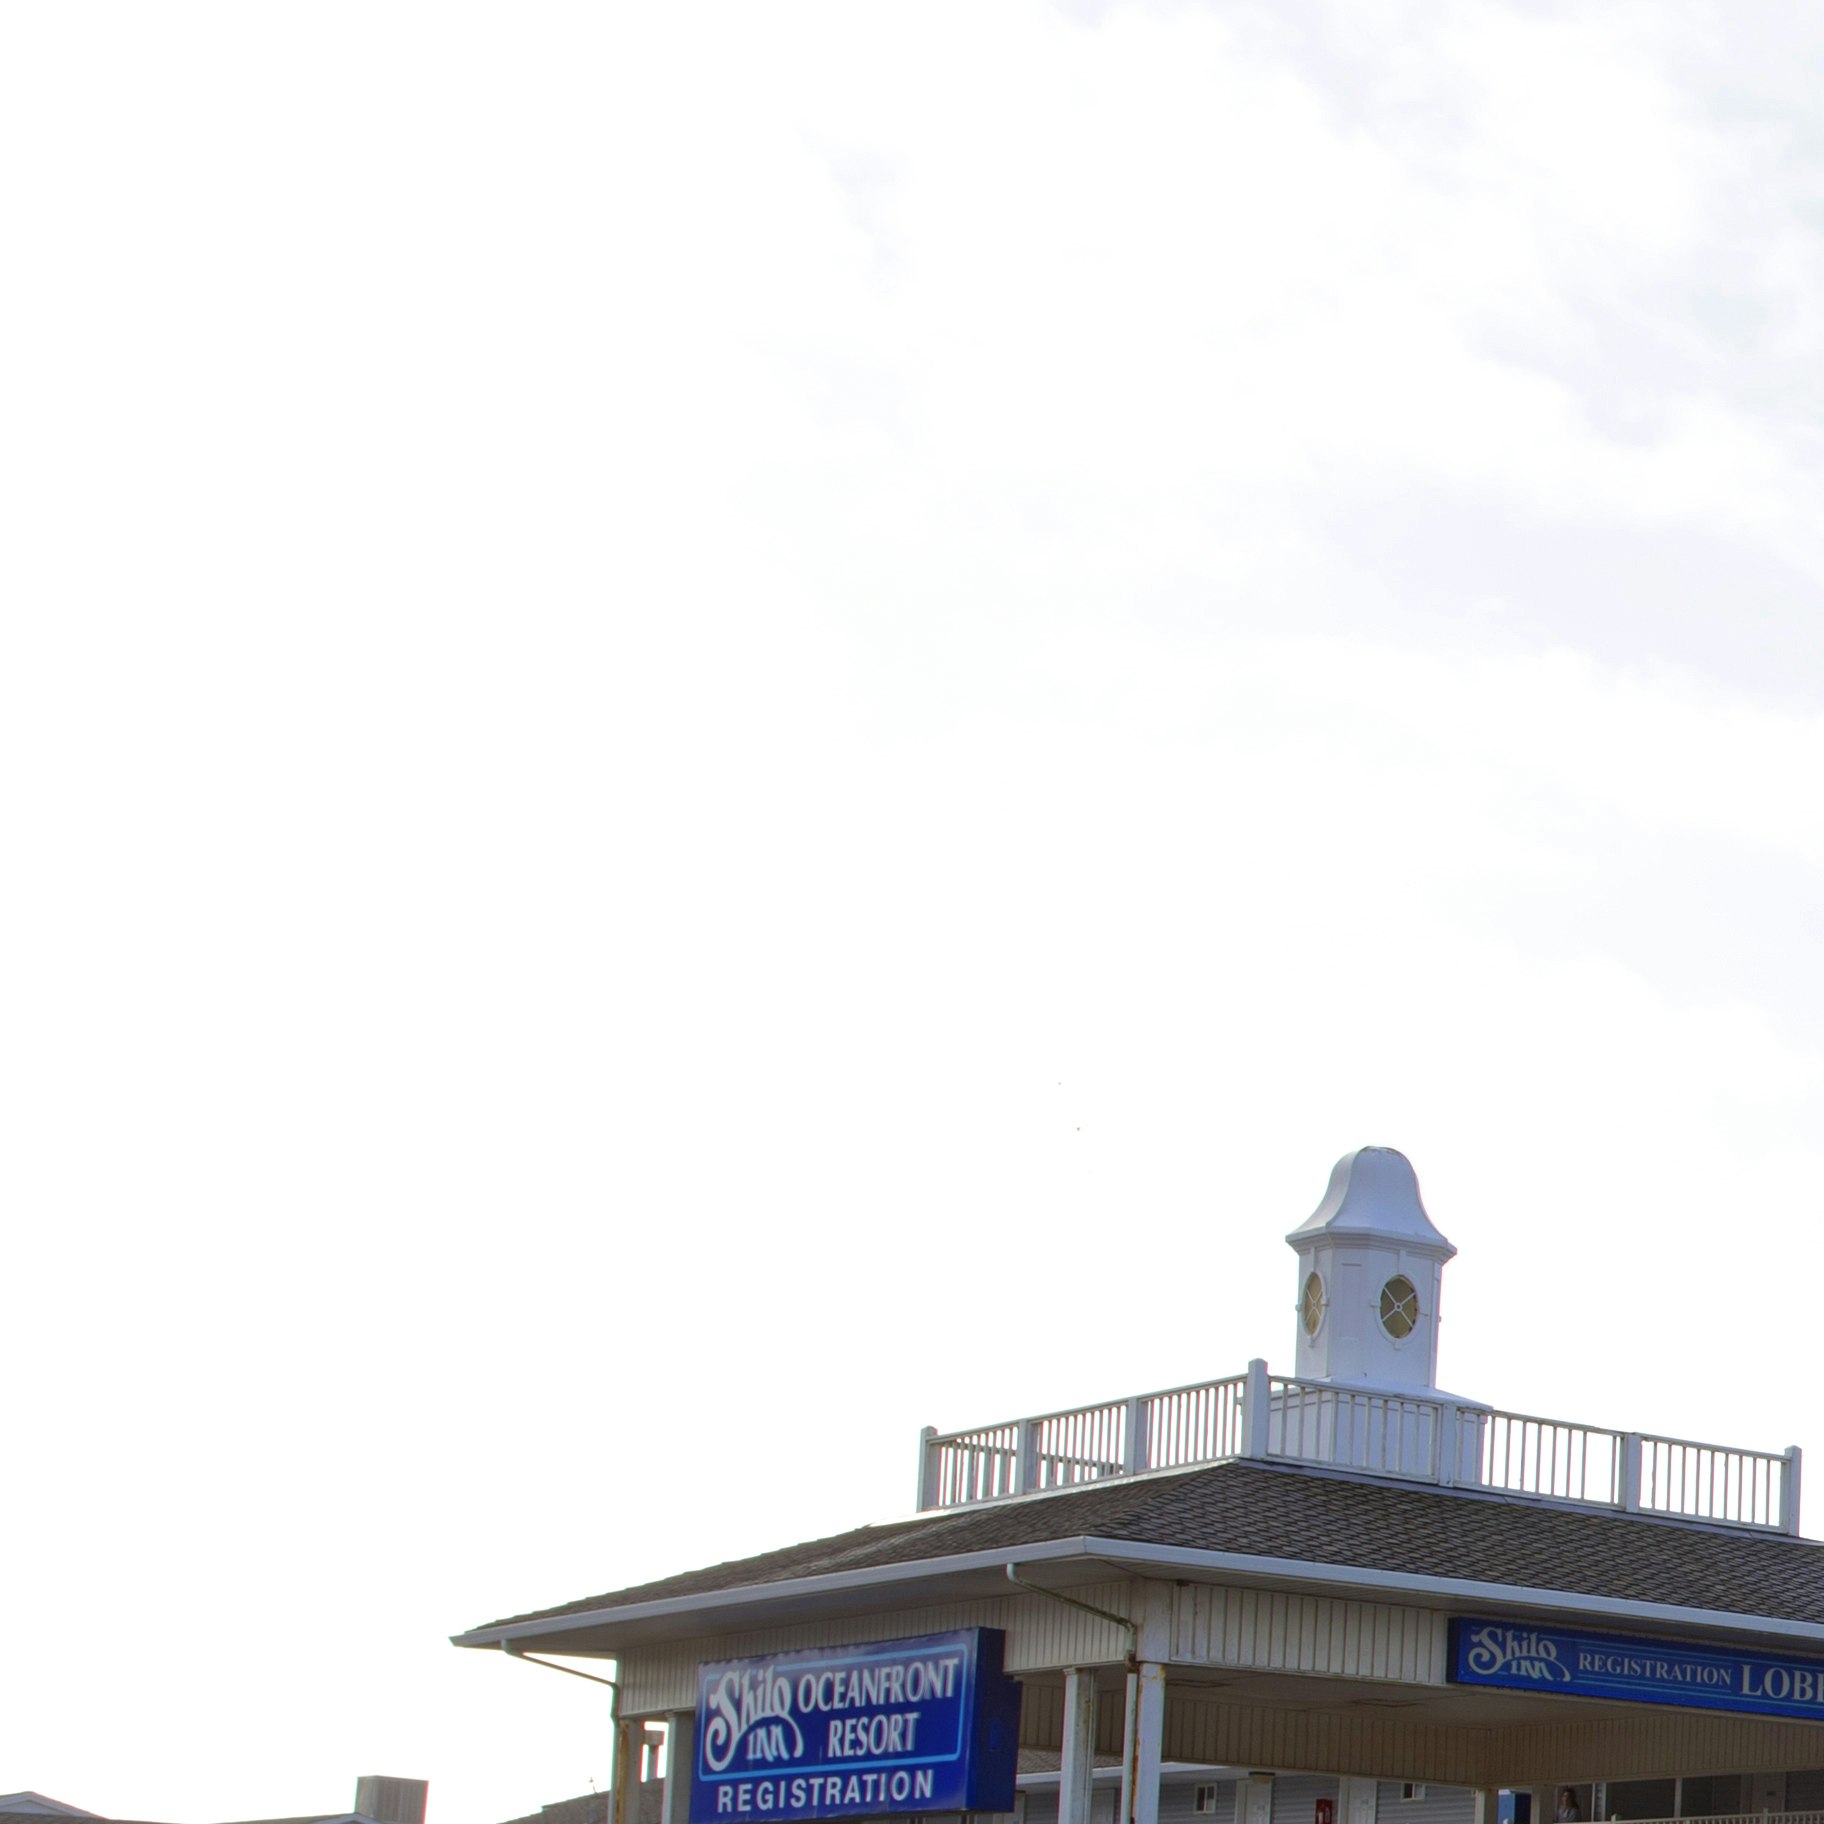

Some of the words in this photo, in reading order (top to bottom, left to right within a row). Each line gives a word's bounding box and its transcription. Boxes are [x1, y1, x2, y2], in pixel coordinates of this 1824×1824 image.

[1469, 1627, 1570, 1681] Shilo
[1578, 1652, 1733, 1686] REGISTRATION
[706, 1664, 804, 1772] Shilo
[797, 1658, 960, 1714] OCEANFRONT
[827, 1712, 921, 1759] RESORT
[717, 1769, 935, 1813] REGISTRATION
